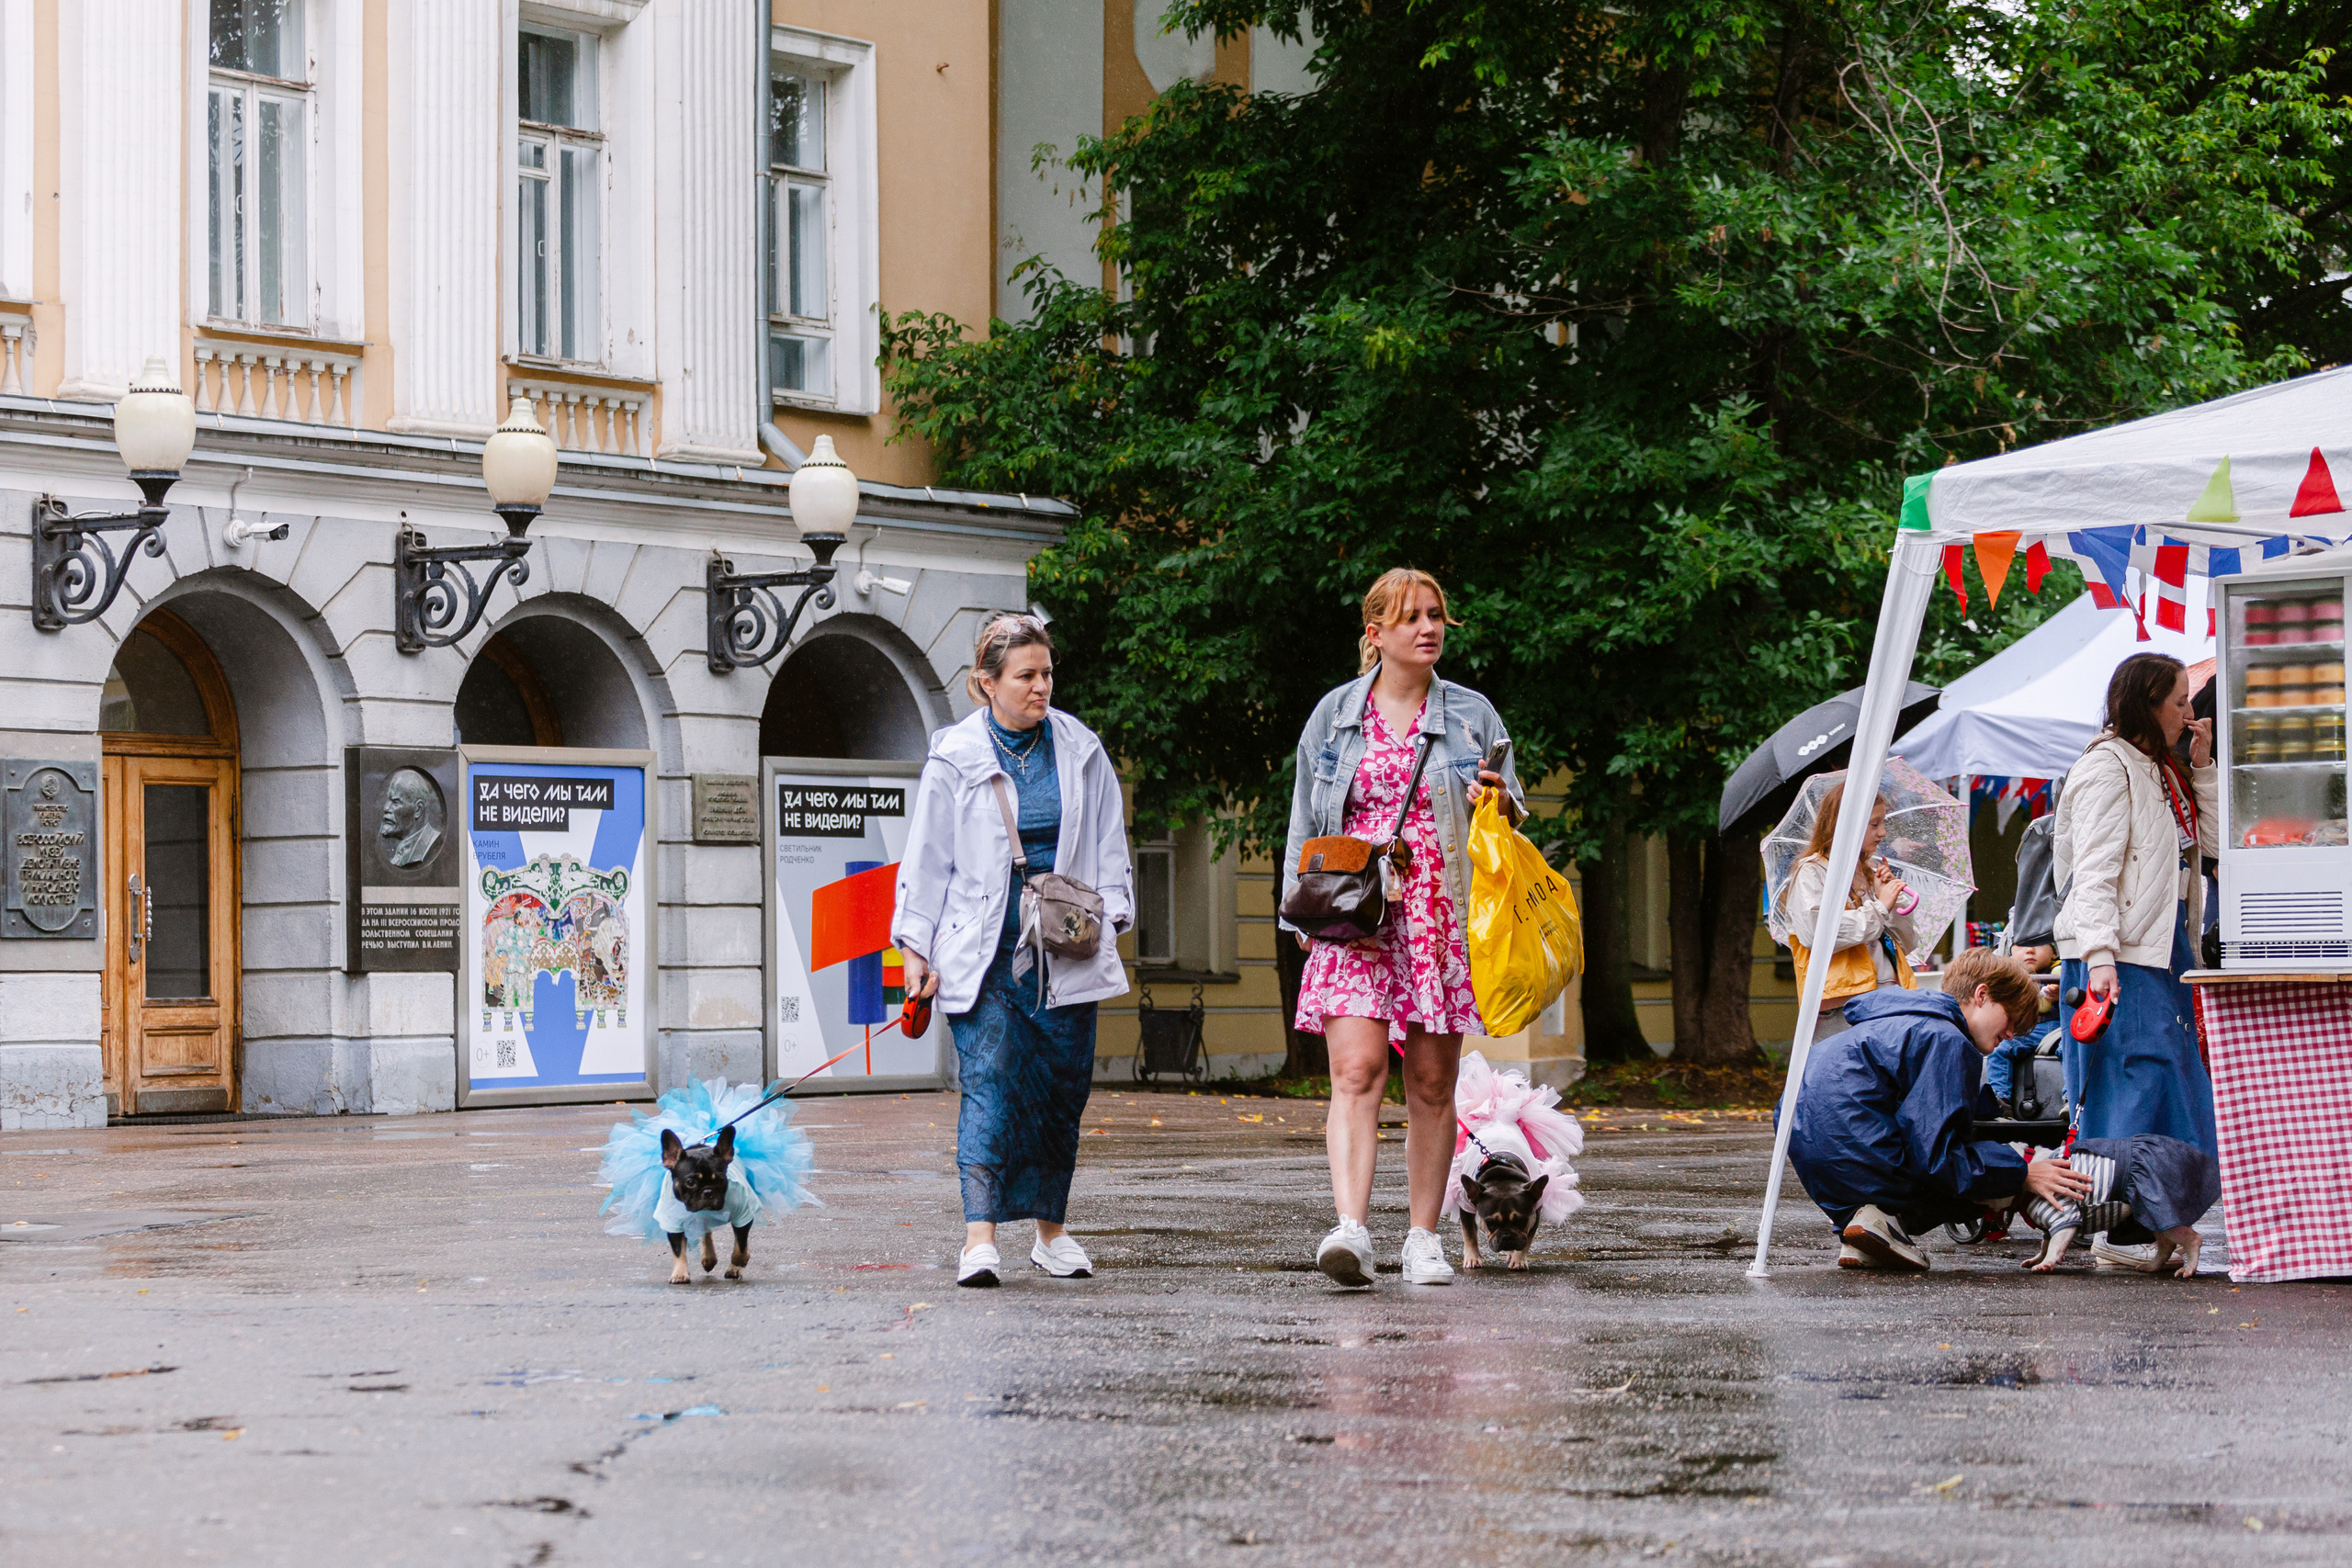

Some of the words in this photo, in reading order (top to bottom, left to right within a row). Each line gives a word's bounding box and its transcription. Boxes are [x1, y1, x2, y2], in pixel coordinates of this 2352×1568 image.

[480, 783, 499, 801] ДА
[544, 784, 571, 801] МЫ
[576, 785, 607, 802] ТАМ
[784, 791, 802, 808] ДА
[841, 793, 866, 808] МЫ
[870, 794, 899, 809] ТАМ
[480, 806, 498, 822] НЕ
[785, 812, 801, 828] НЕ
[473, 840, 500, 848] КАМИН
[779, 844, 822, 853] СВЕТИЛЬНИК
[473, 852, 506, 860] ВРУБЕЛЯ
[780, 855, 815, 863] РОДЧЕНКО
[26, 894, 76, 906] ИСКУССТВА
[367, 908, 383, 916] ЭТОМ
[385, 908, 409, 916] ЗДАНИИ
[410, 908, 417, 916] 16
[418, 908, 438, 916] ИЮНЯ
[439, 908, 451, 916] 1921
[362, 919, 370, 927] ДА
[371, 919, 379, 927] НА
[361, 930, 411, 938] ВОЛЬСТВЕННОМ
[415, 930, 454, 938] СОВЕЩАНИИ
[362, 941, 384, 949] РЕЧЬЮ
[387, 941, 420, 949] ВЫСТУПИЛ
[784, 1039, 797, 1052] 0+
[476, 1048, 490, 1061] 0+
